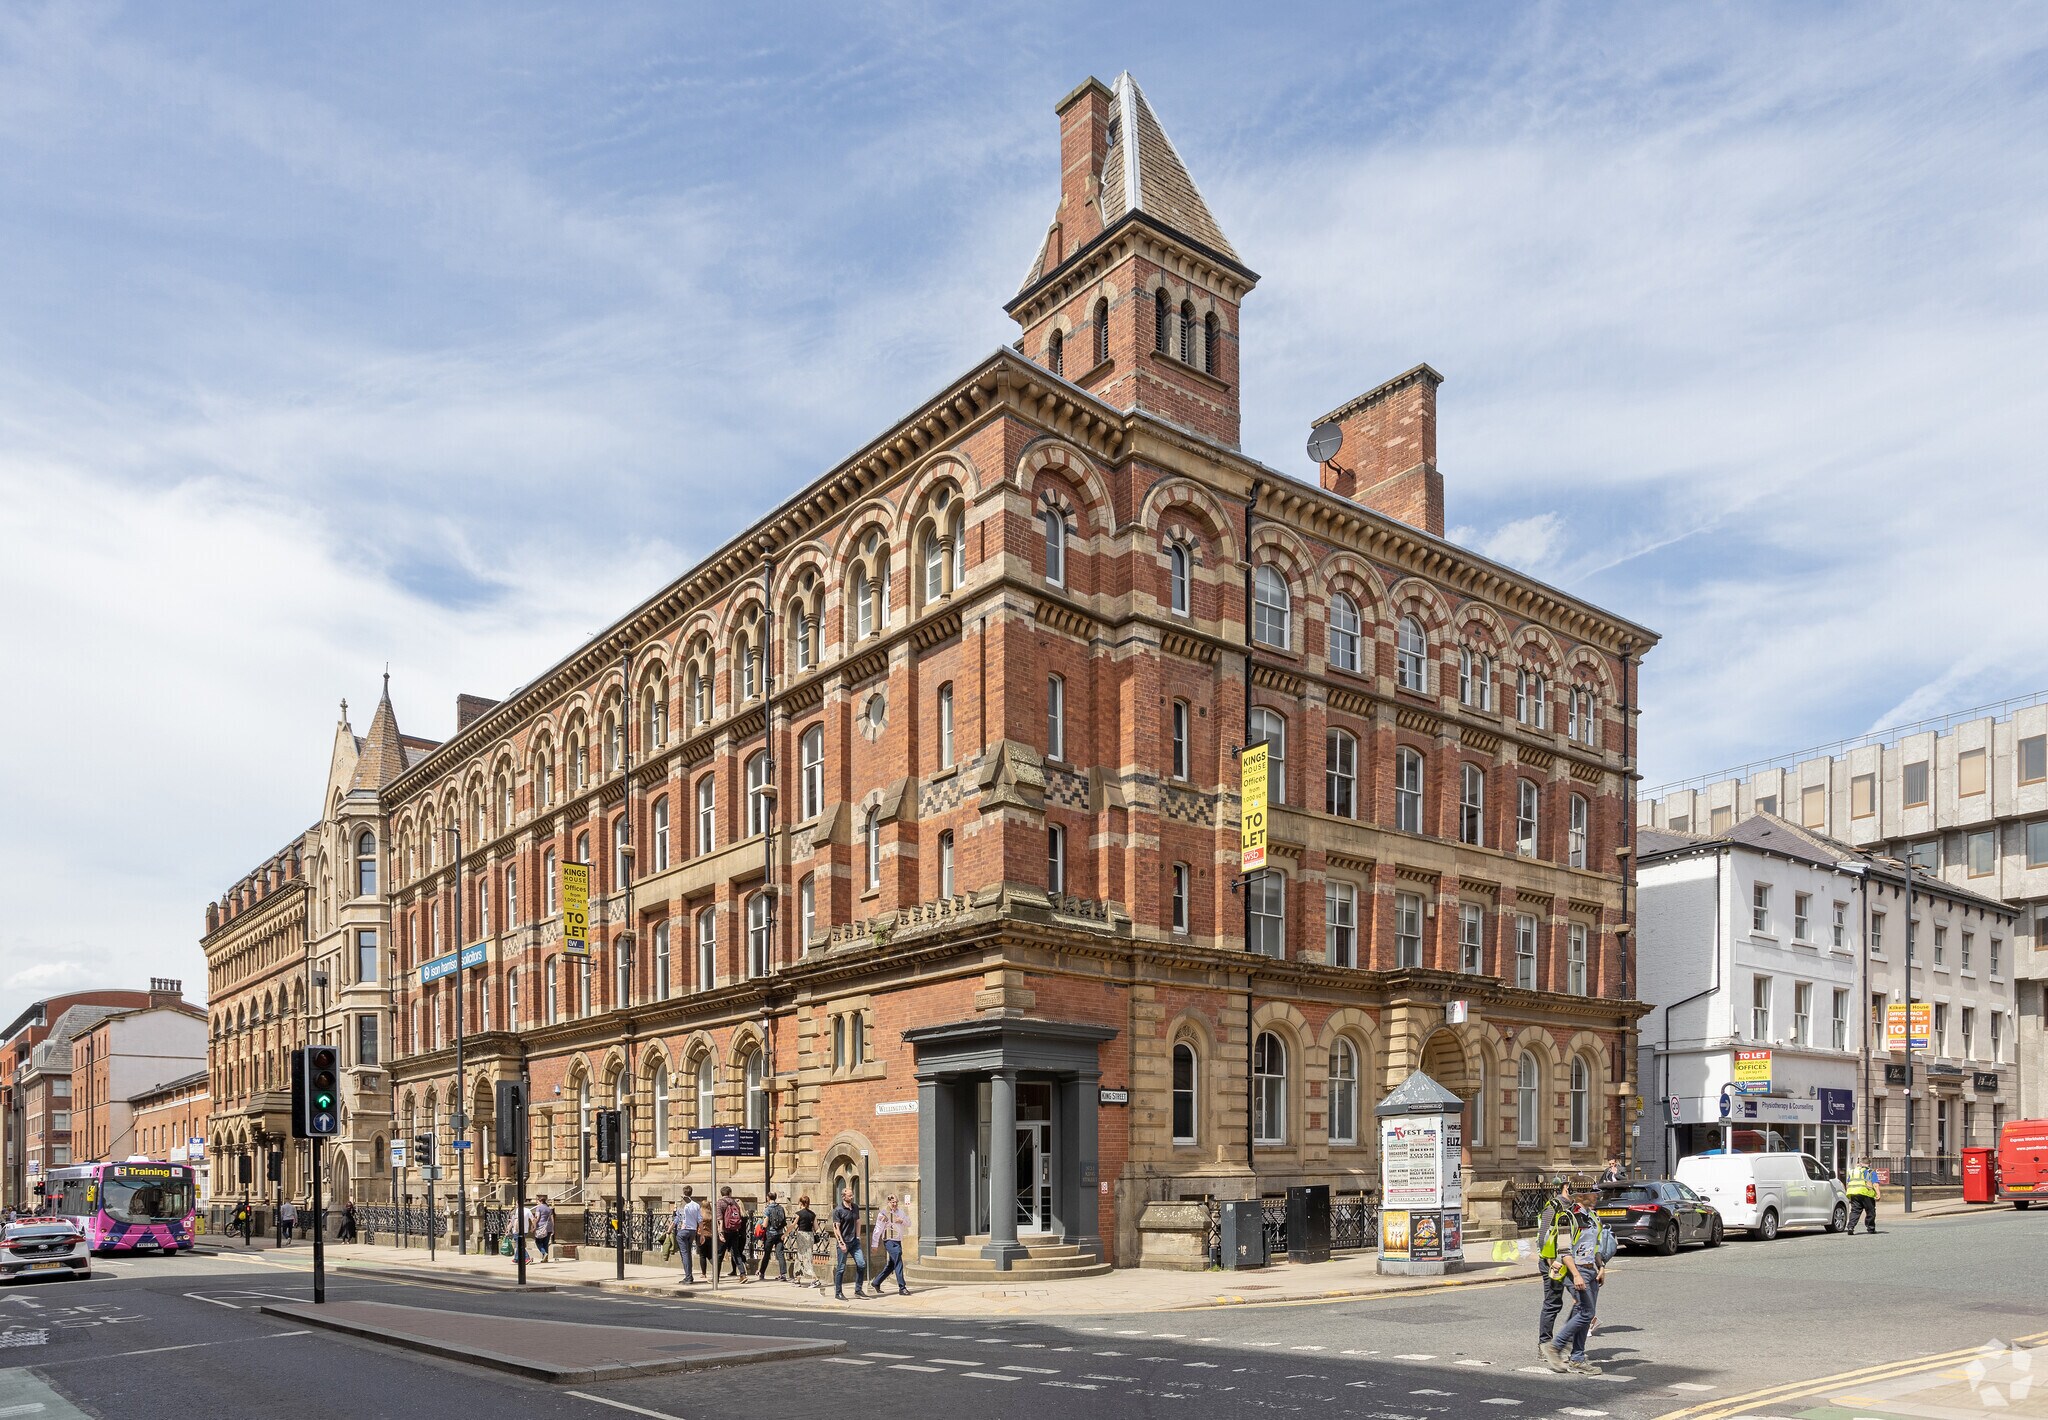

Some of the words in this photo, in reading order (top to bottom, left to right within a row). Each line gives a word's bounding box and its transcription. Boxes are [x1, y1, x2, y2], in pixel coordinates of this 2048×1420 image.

[1244, 751, 1266, 767] KINGS
[1244, 762, 1266, 774] HOUSE
[1244, 775, 1266, 788] Offices
[1245, 812, 1262, 830] TO
[1242, 829, 1265, 849] LET
[1244, 850, 1259, 862] wsb
[564, 868, 586, 877] KINGS
[567, 912, 584, 924] TO
[564, 925, 587, 937] LET
[441, 958, 457, 973] harriso
[1889, 1025, 1906, 1034] TO
[1910, 1024, 1928, 1034] LET
[1112, 1092, 1126, 1100] STREET
[1672, 1102, 1679, 1110] 20
[1762, 1102, 1788, 1112] Physiotherapy
[1447, 1137, 1461, 1146] ELIZ
[129, 1167, 170, 1177] Training
